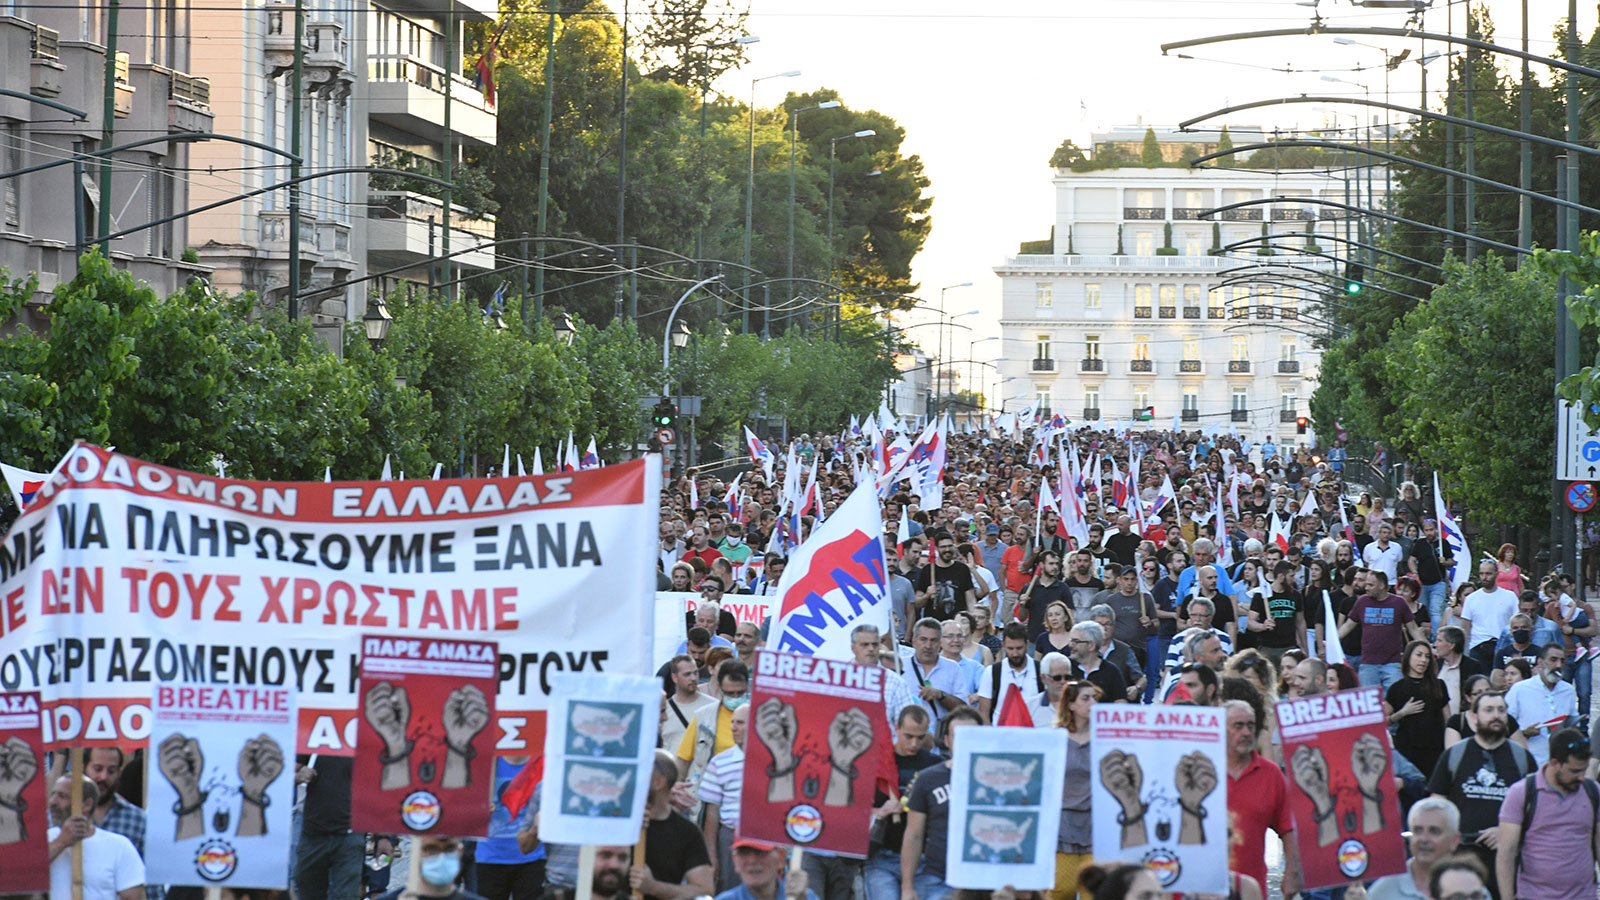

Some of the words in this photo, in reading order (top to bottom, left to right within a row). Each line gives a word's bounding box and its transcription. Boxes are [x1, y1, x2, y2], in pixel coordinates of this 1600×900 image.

[332, 476, 574, 518] ΕΛΛΑΔΑΣ
[128, 504, 456, 573] ΠΛΗΡΩΣΟΥΜΕ
[474, 521, 602, 571] ΞΑΝΑ
[121, 567, 242, 621] ΤΟΥΣ
[258, 577, 520, 631] ΧΡΩΣΤΑΜΕ
[365, 638, 421, 658] ΠΑΡΕ
[426, 641, 495, 662] ΑΝΑΣΑ
[757, 651, 882, 691] BREATHE
[158, 687, 289, 712] BREATHE
[1277, 689, 1382, 726] BREATHE
[1096, 710, 1147, 725] ΠΑΡΕ
[1154, 712, 1219, 728] ΑΝΑΣΑ
